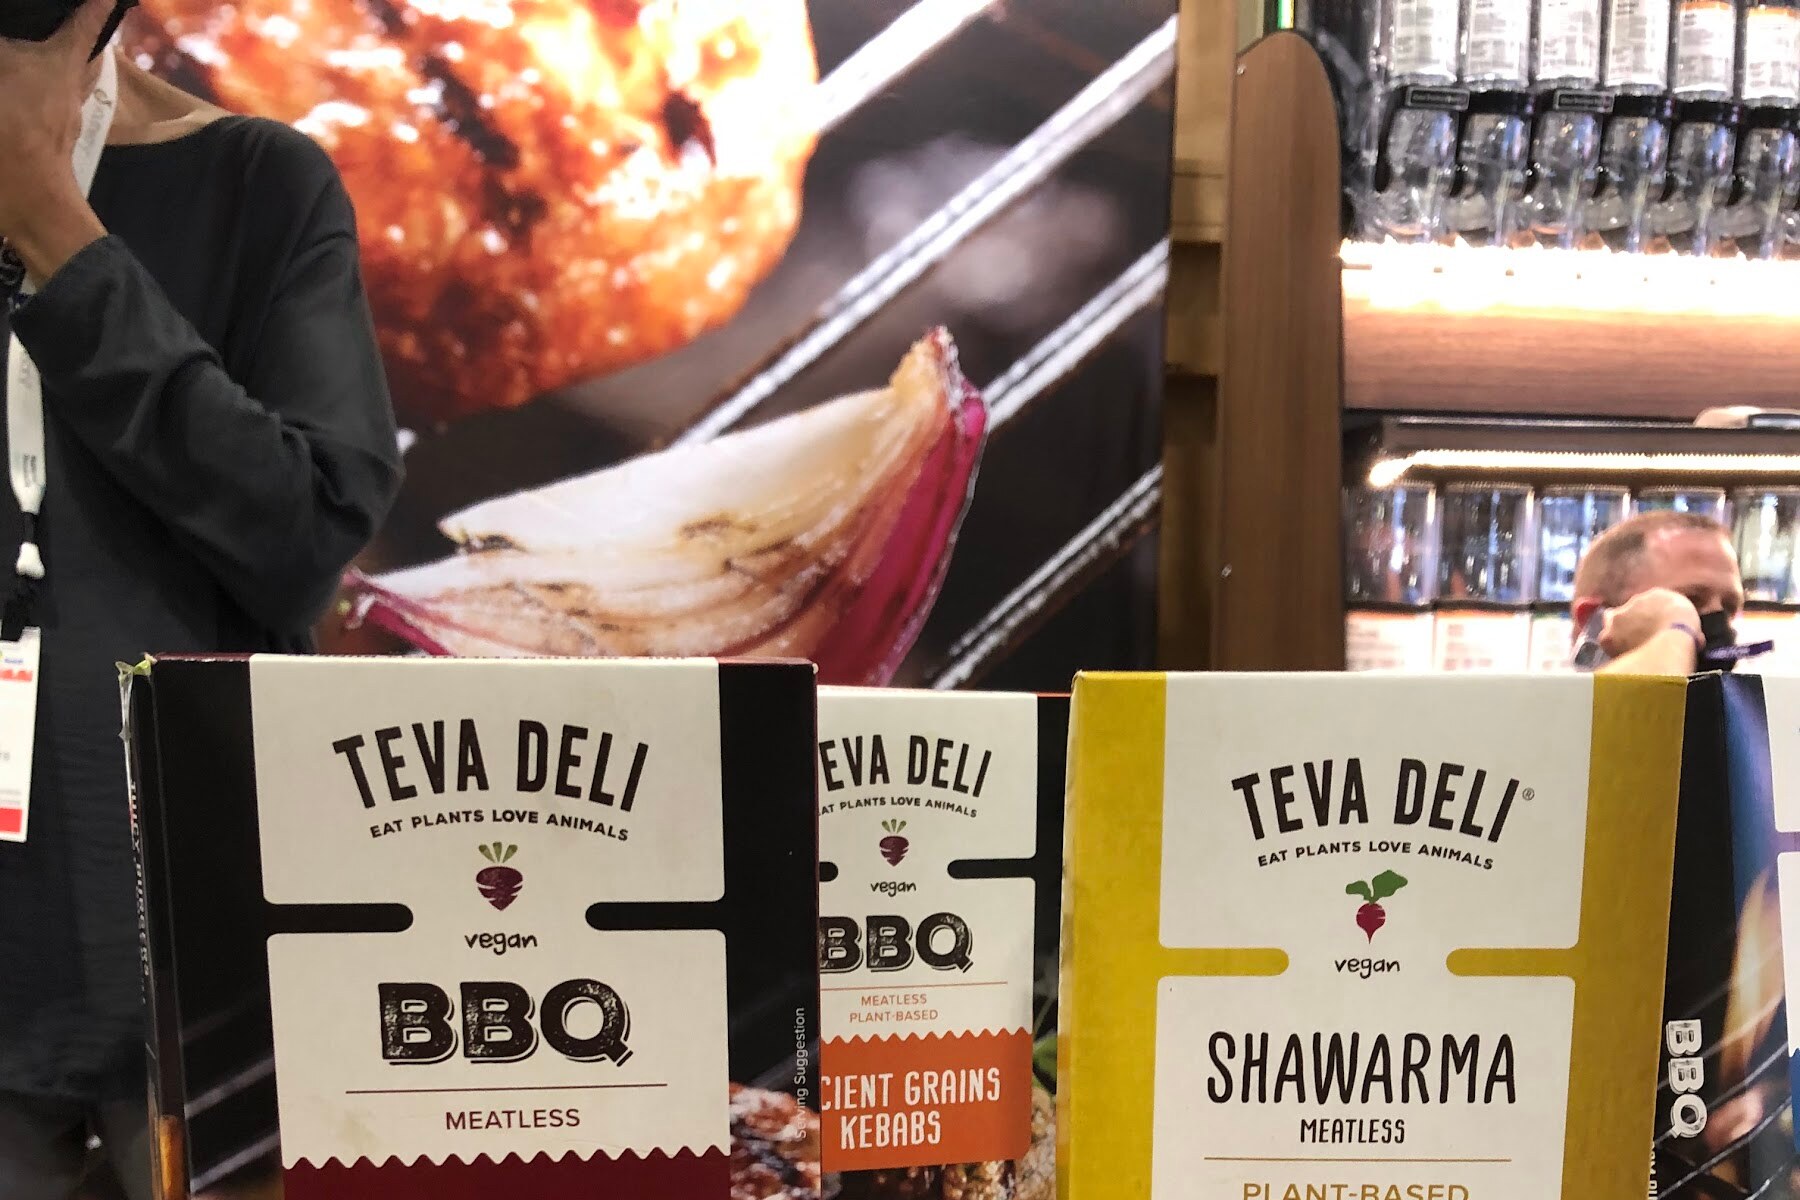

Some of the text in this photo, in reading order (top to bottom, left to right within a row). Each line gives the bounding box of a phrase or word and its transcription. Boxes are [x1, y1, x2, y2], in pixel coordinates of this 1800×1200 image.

[333, 719, 649, 812] TEVA DELI
[818, 734, 992, 798] EVA DELI
[818, 796, 978, 818] AT PLANTS LOVE ANIMALS
[1232, 757, 1369, 841] TEVA
[370, 809, 630, 841] EAT PLANTS LOVE ANIMALS
[1258, 840, 1494, 870] EAT PLANTS LOVE ANIMALS
[870, 880, 917, 897] vegan
[464, 930, 538, 956] vegan
[819, 912, 973, 973] BBQ
[1334, 956, 1401, 980] vegan
[849, 1009, 939, 1024] PLANT-BASED
[861, 993, 927, 1008] MEATLESS
[378, 978, 634, 1067] BBQ
[794, 1008, 808, 1085] Suggestion
[1206, 1031, 1517, 1105] SHAWARMA
[1666, 1019, 1708, 1140] BBQ
[821, 1067, 1000, 1111] CIENT GRAINS
[445, 1108, 581, 1130] MEATLESS
[840, 1110, 941, 1150] KEBABS
[1299, 1118, 1406, 1144] MEATLESS
